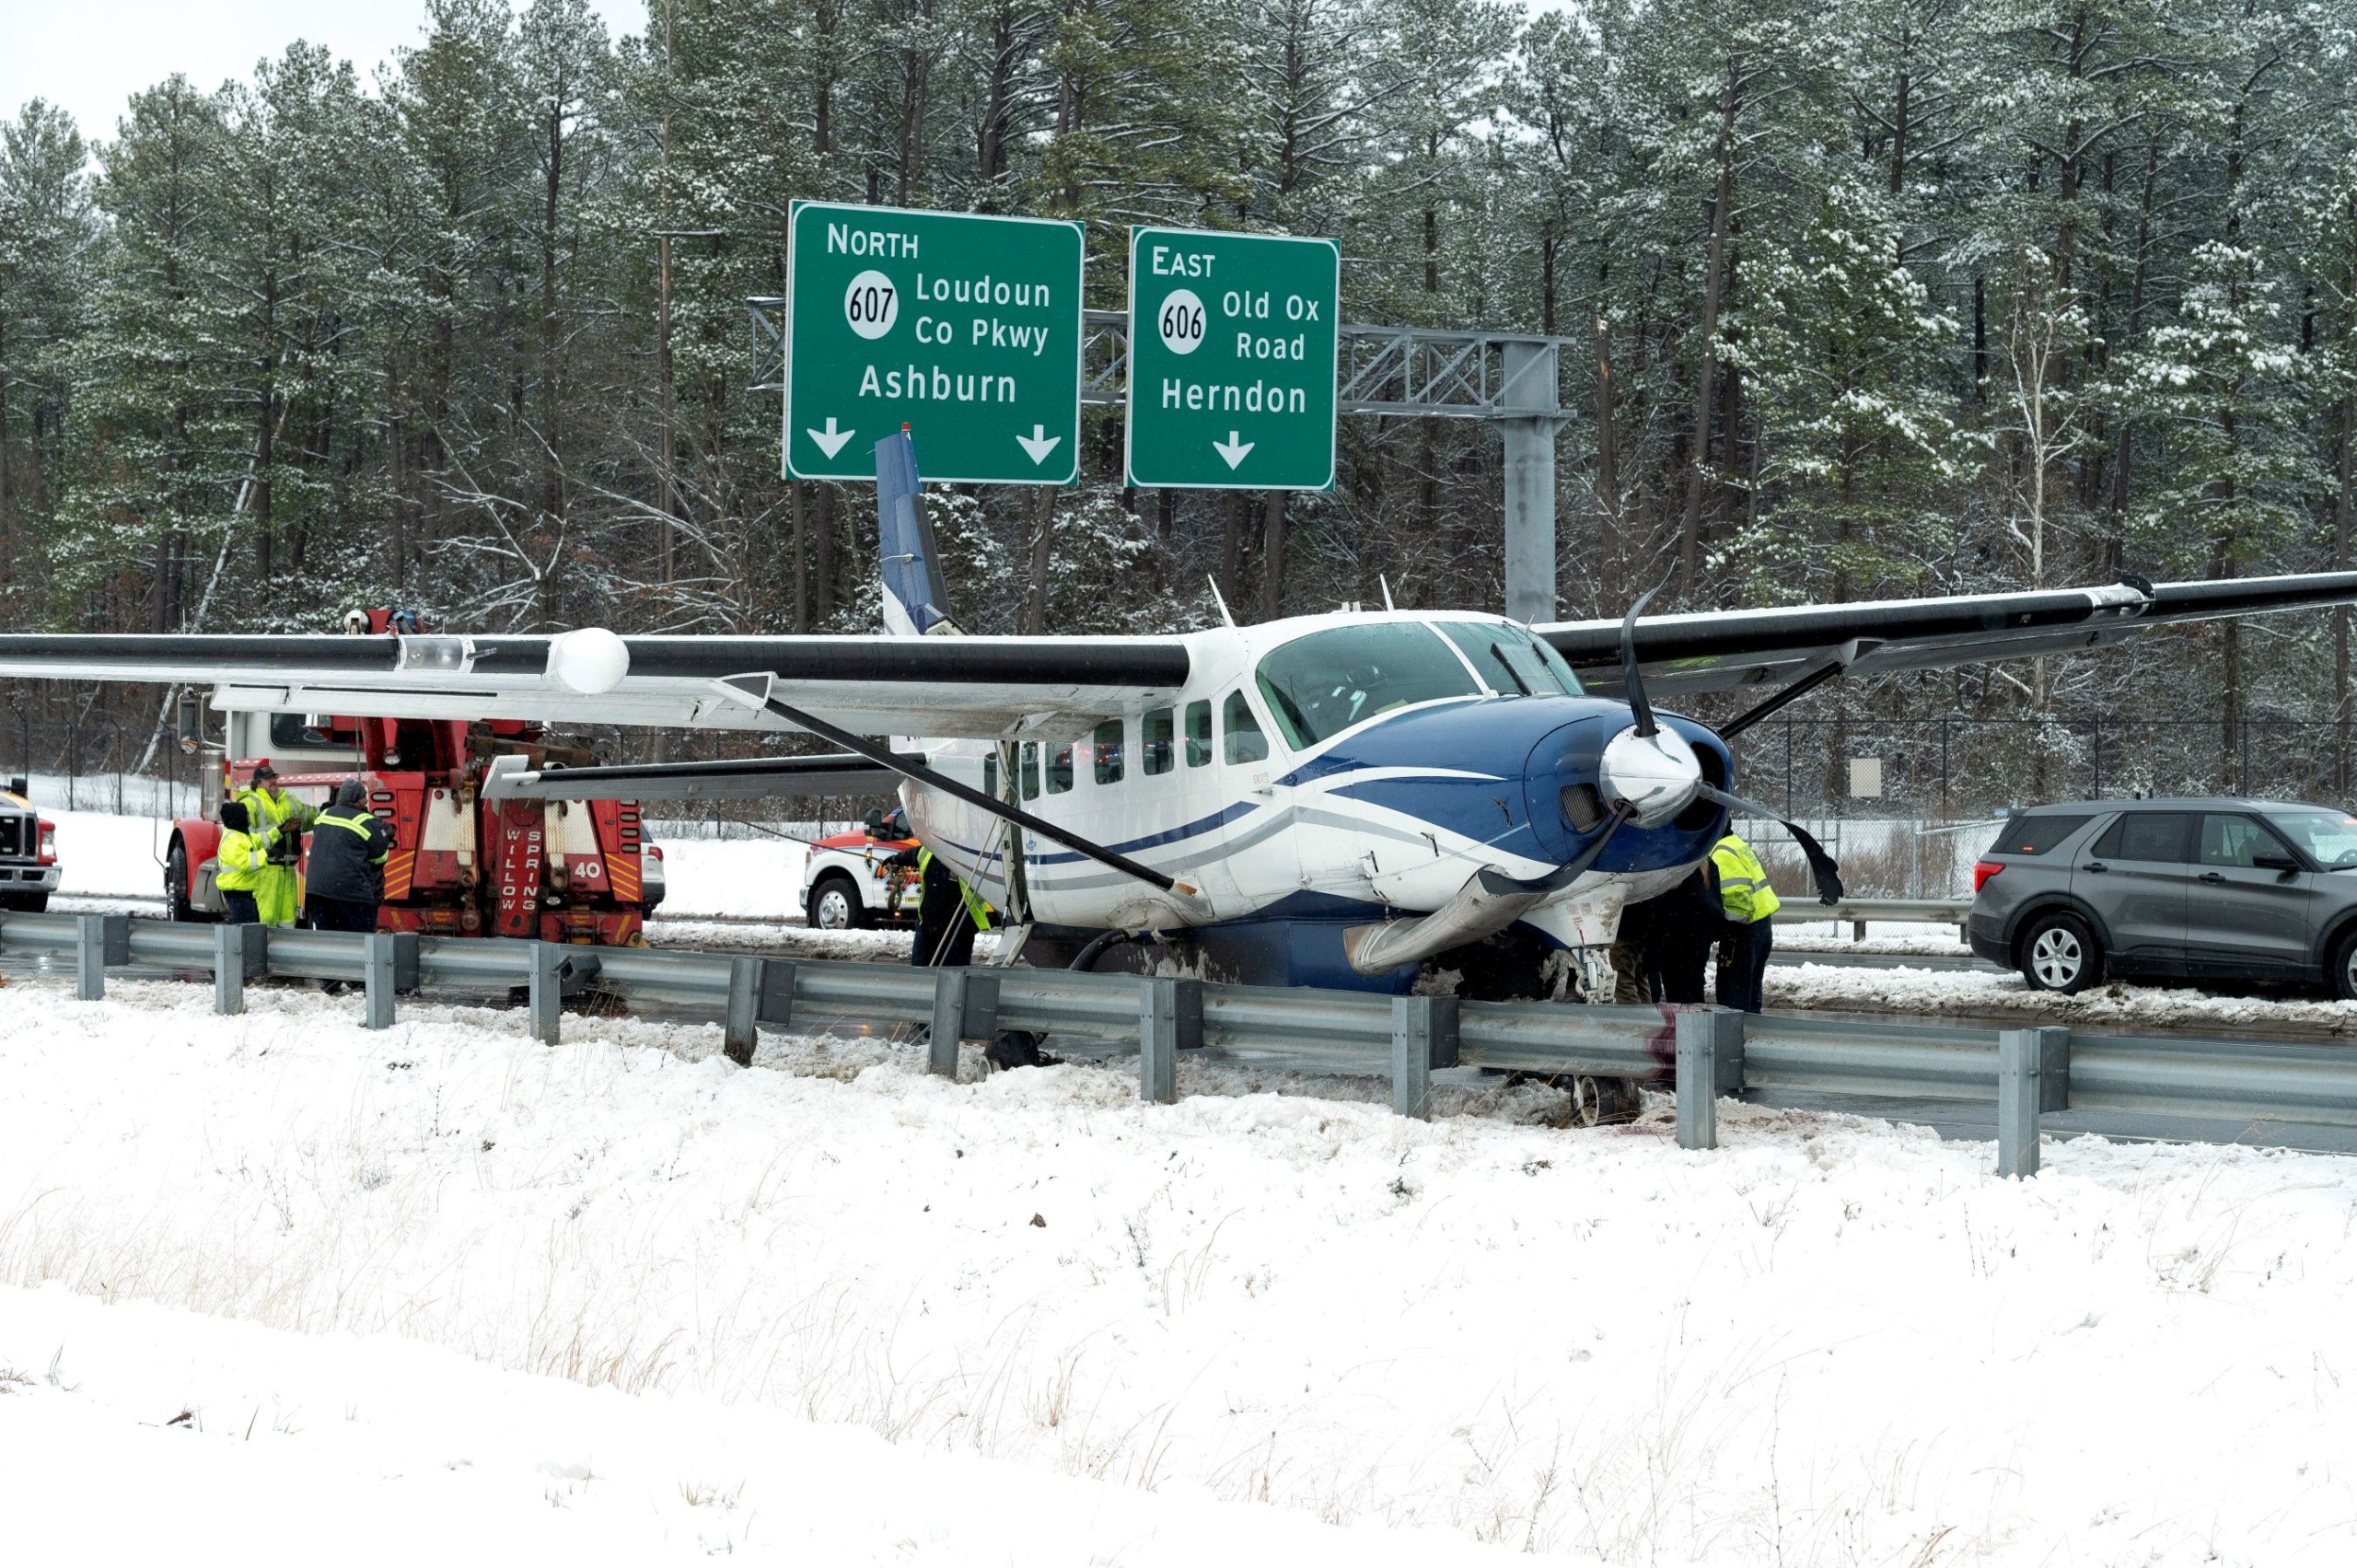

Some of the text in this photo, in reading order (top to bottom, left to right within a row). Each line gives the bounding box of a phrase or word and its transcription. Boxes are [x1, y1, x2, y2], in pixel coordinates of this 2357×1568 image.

[829, 223, 918, 259] NORTH
[1153, 246, 1215, 277] EAST
[850, 286, 894, 323] 607
[917, 273, 1050, 307] Loudoun
[1223, 290, 1319, 321] Old Ox
[915, 316, 1049, 356] Co Pkwy
[1163, 305, 1202, 340] 606
[1237, 332, 1305, 361] Road
[858, 364, 1016, 402] Ashburn
[1162, 378, 1306, 413] Herndon
[502, 830, 520, 910] WILLOW
[522, 830, 541, 911] SPRING
[575, 862, 601, 878] 40
